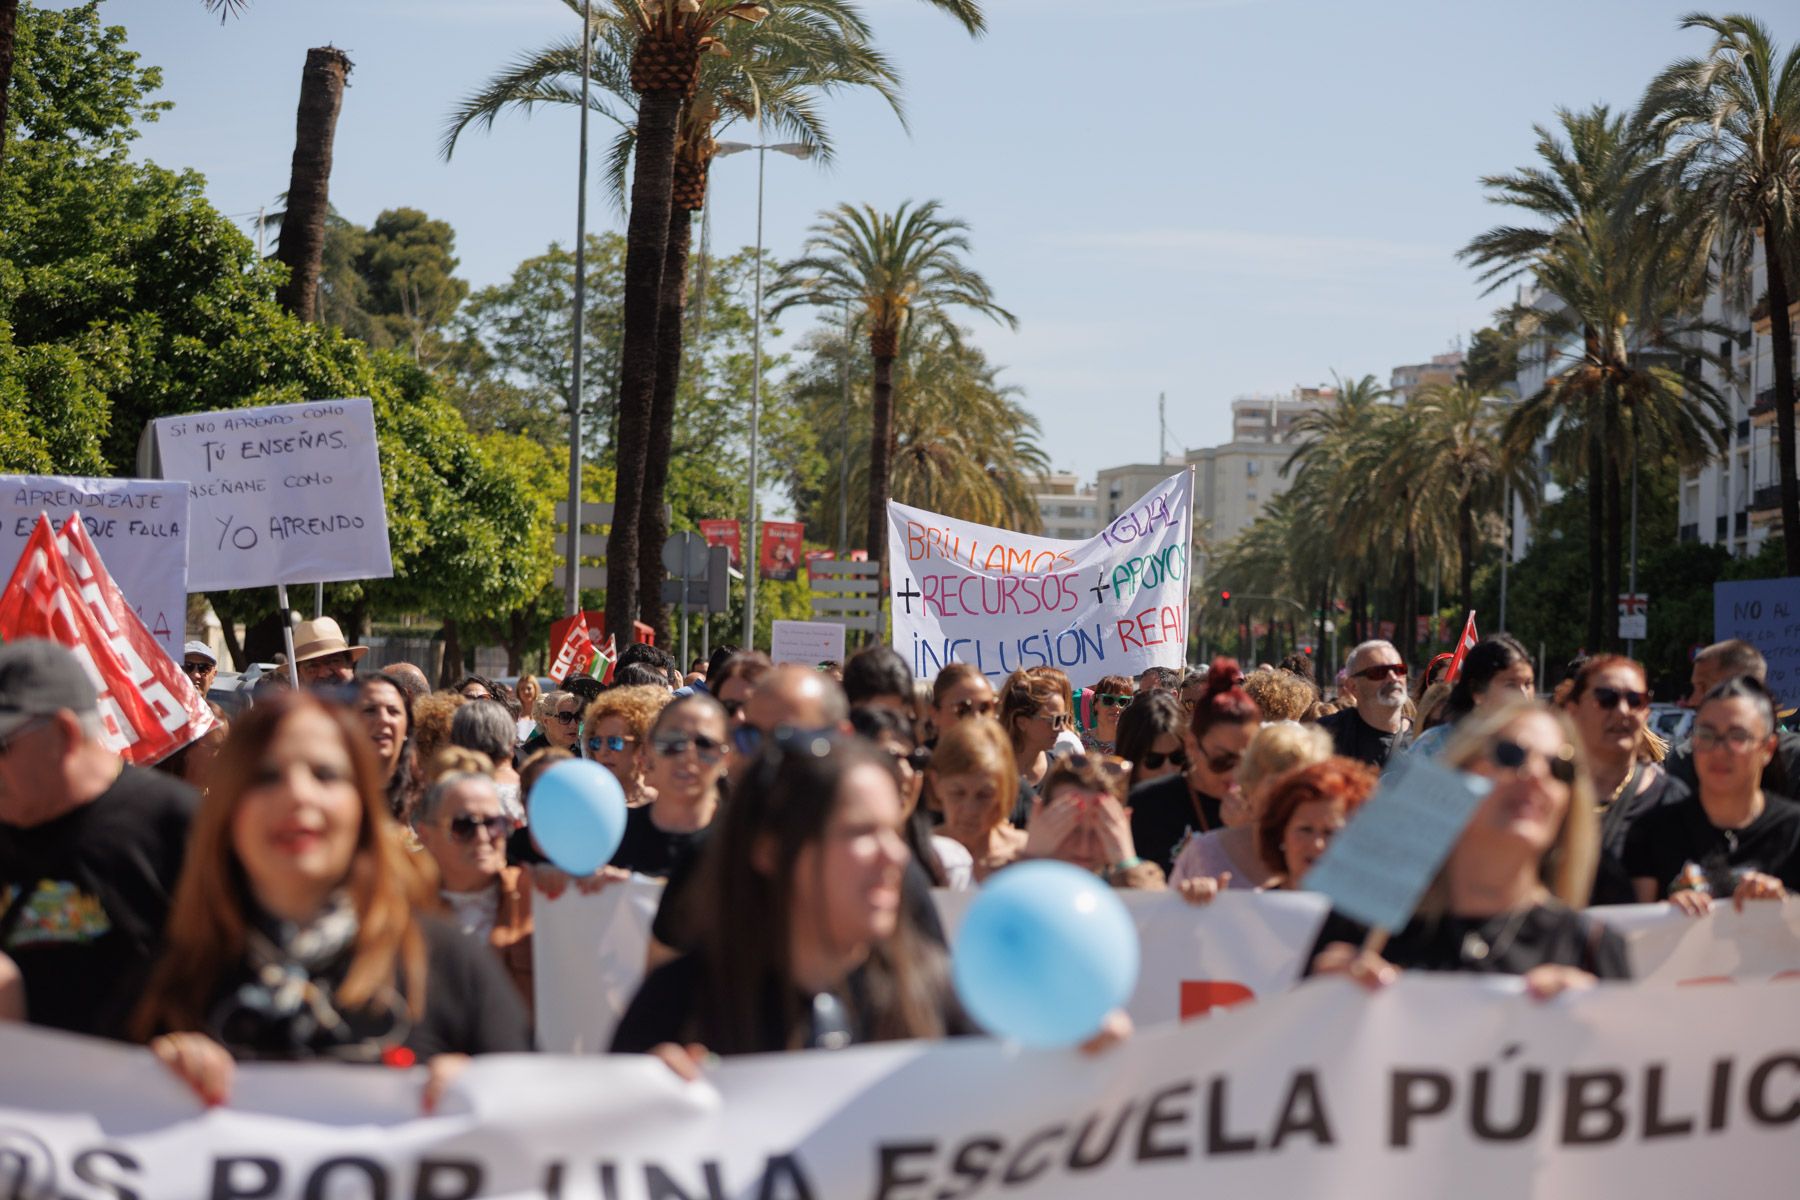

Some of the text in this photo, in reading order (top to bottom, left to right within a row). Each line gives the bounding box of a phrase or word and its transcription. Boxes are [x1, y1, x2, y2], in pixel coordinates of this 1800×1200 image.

[196, 421, 216, 433] NO
[224, 414, 294, 431] APRENDO
[302, 405, 345, 418] COMO
[202, 440, 226, 473] TÚ
[284, 476, 334, 489] COMO
[15, 488, 163, 510] APRENDIZAJE
[128, 519, 180, 538] FALLA
[216, 514, 365, 551] YO APRENDO
[1102, 492, 1179, 548] IGUAL
[1734, 600, 1762, 621] NO
[876, 1067, 1334, 1200] ESCUELA
